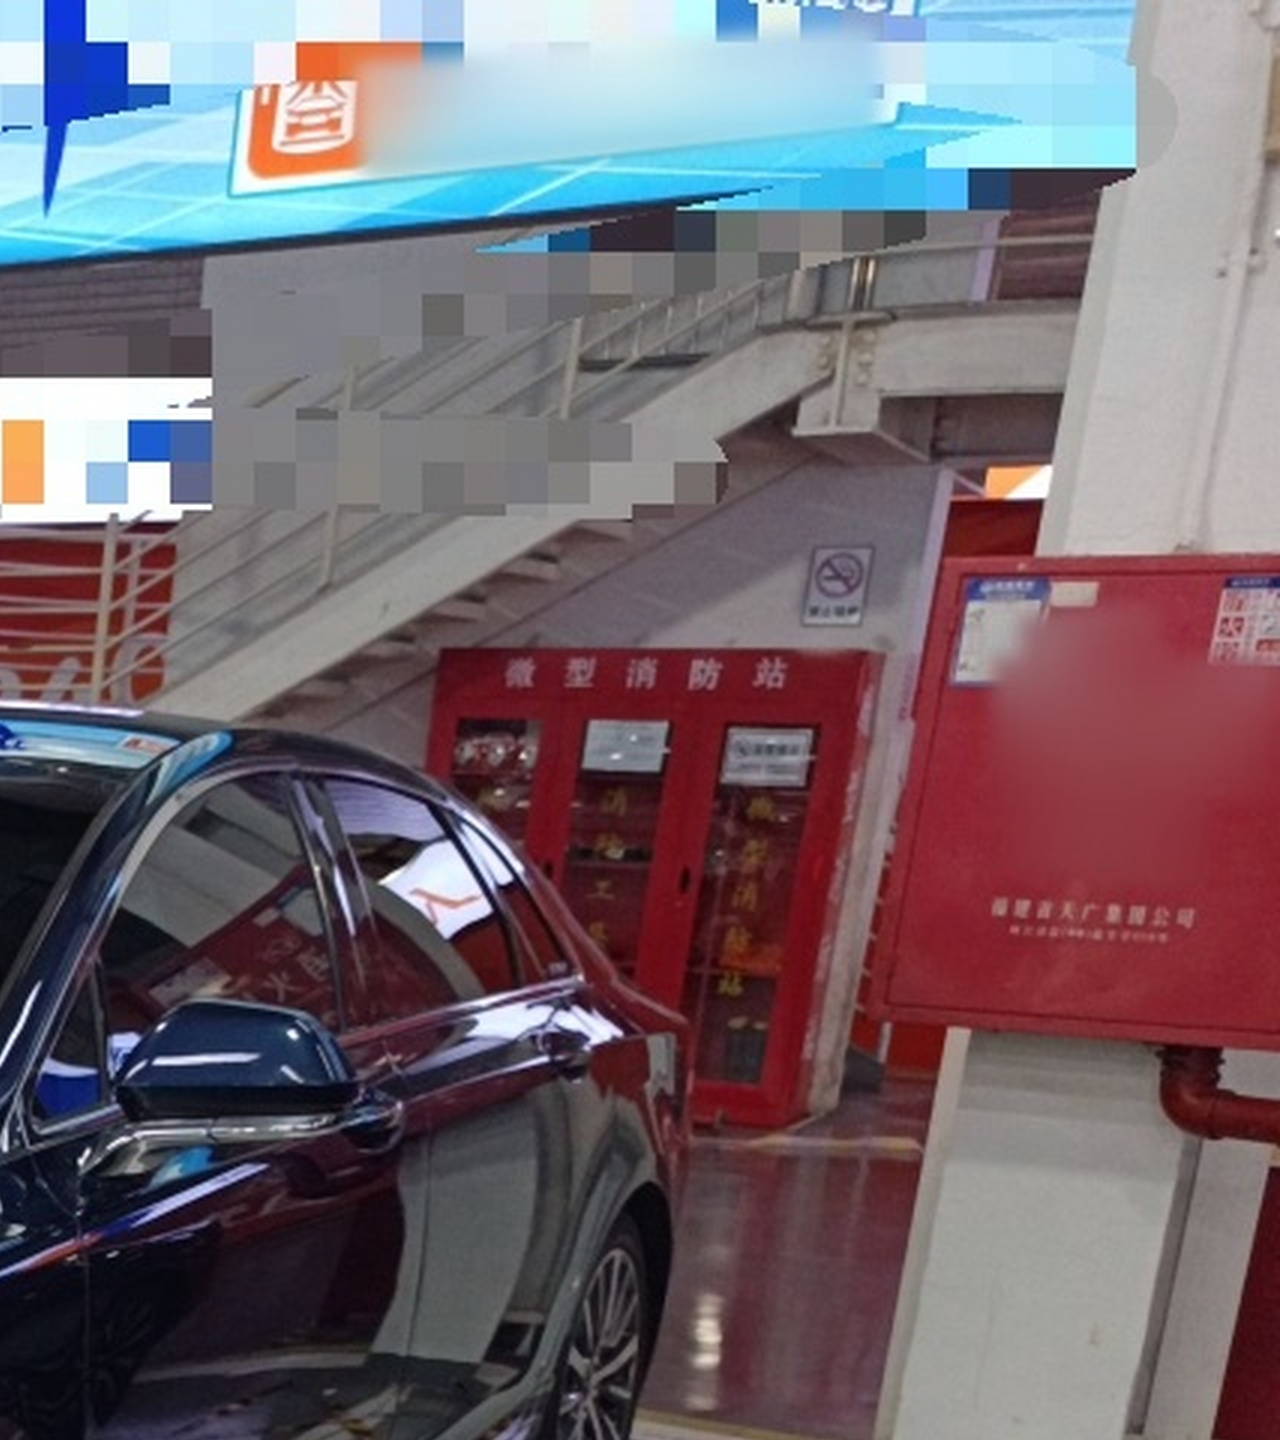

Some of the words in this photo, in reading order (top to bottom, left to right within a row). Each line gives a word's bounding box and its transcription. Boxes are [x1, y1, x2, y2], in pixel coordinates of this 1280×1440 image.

[504, 656, 788, 691] 微型消防站
